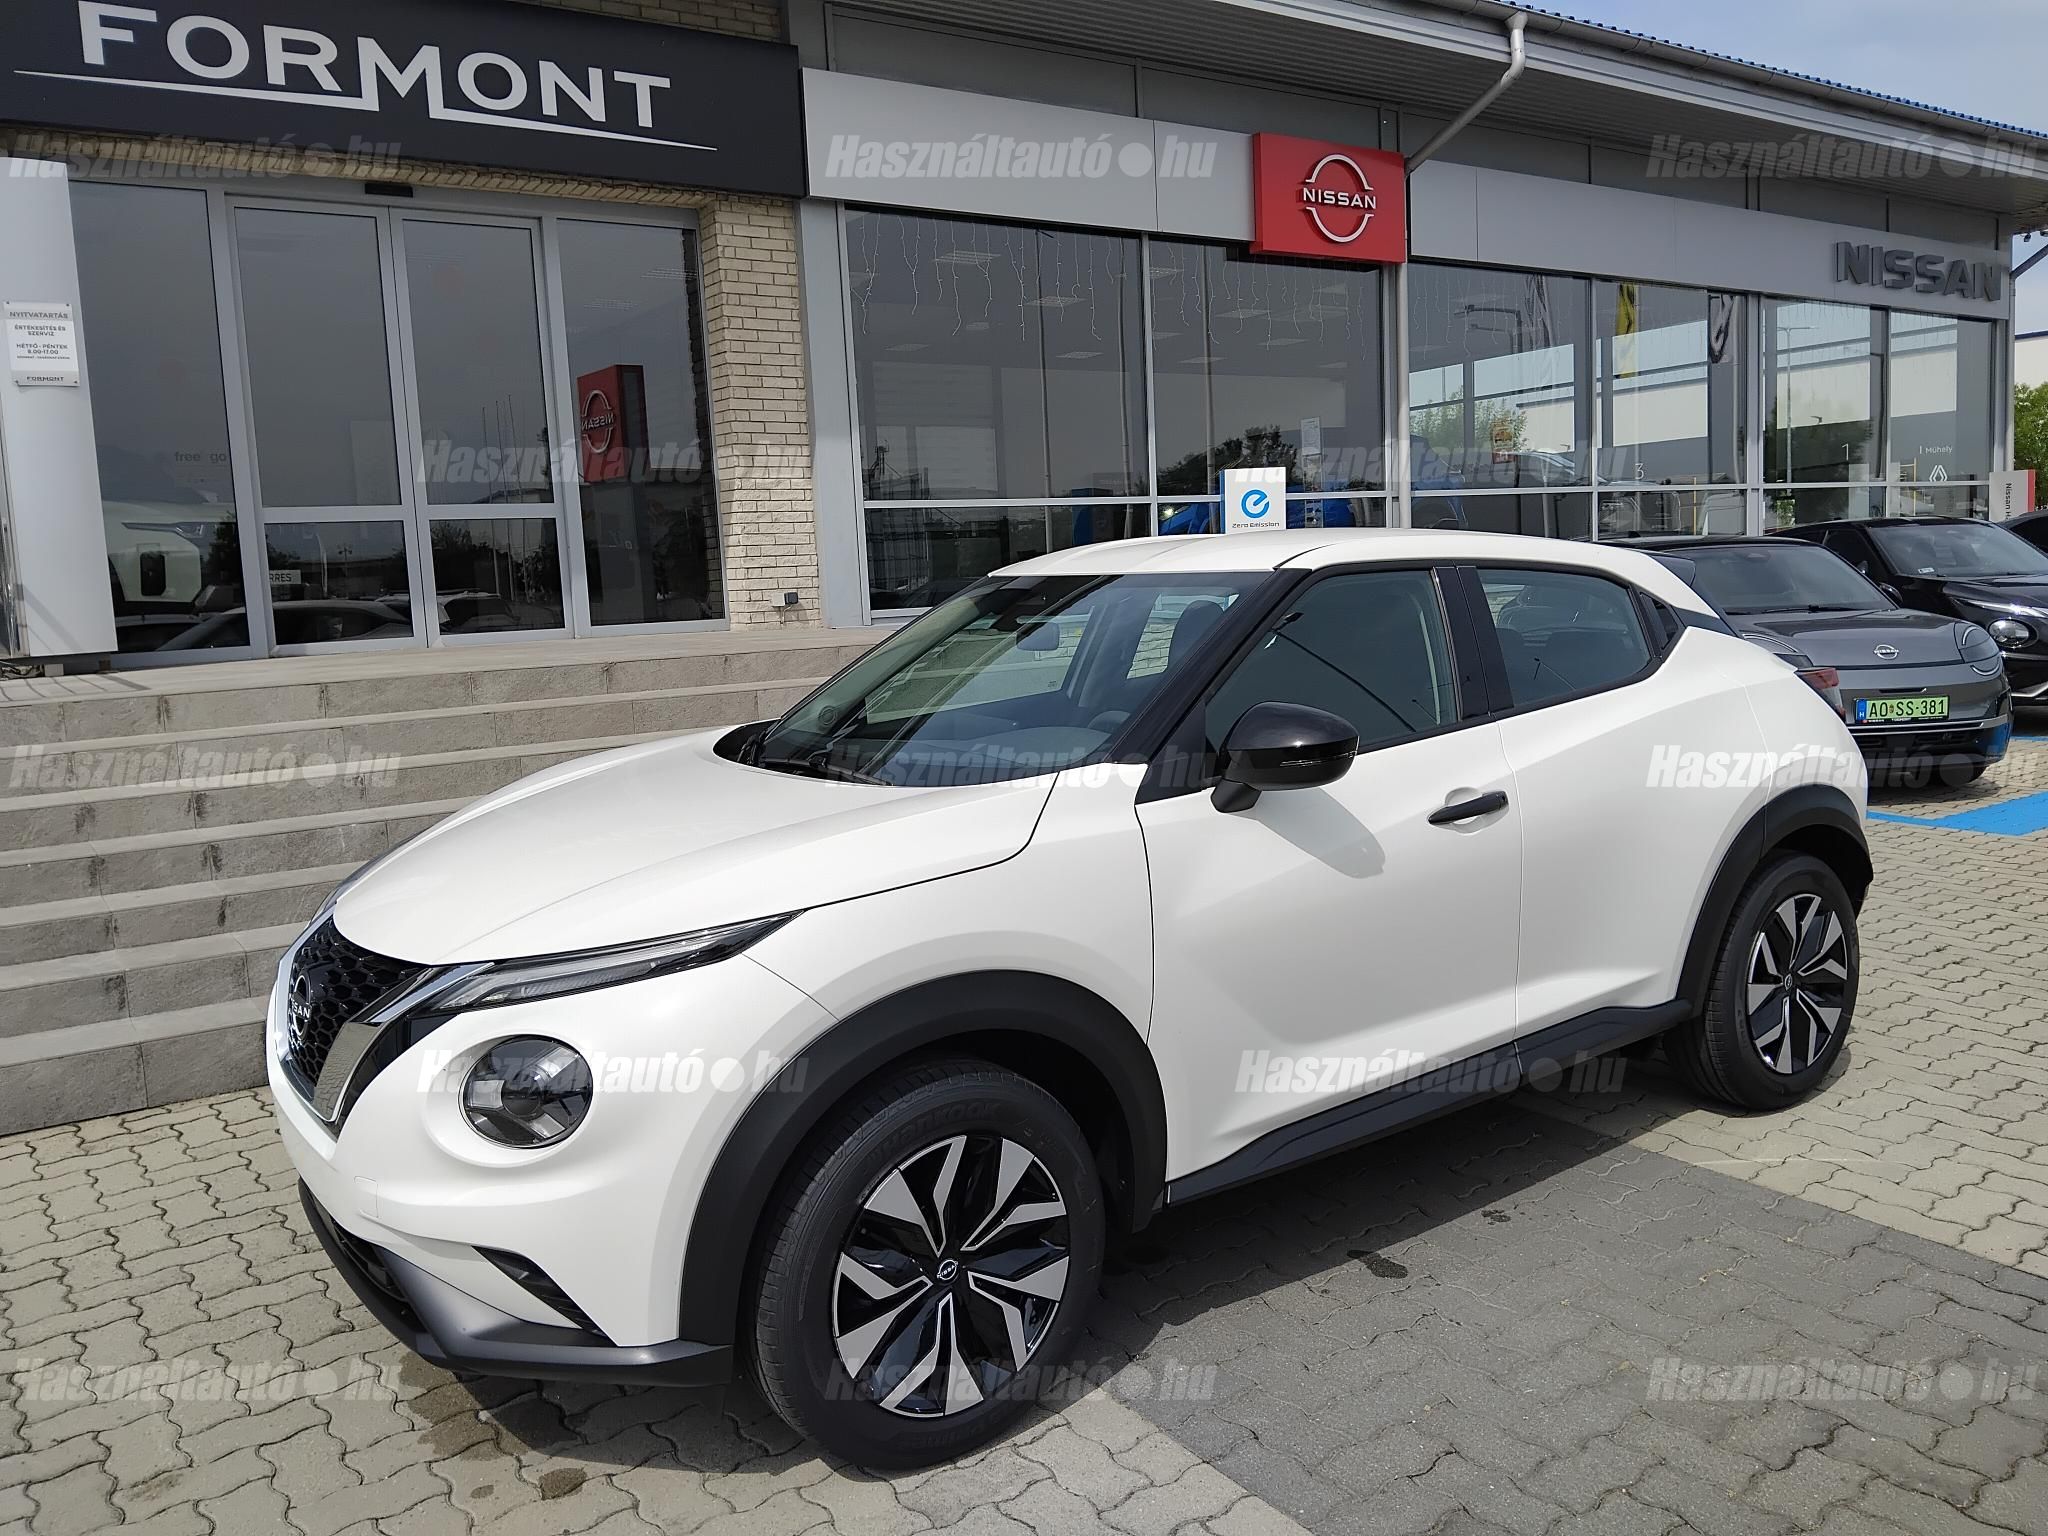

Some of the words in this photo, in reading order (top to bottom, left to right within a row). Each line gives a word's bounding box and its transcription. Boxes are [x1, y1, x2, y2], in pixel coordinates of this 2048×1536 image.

[77, 0, 671, 130] FORMONT
[1303, 187, 1377, 209] NISSAN
[1836, 241, 2001, 301] NISSAN
[1634, 463, 1645, 481] 3
